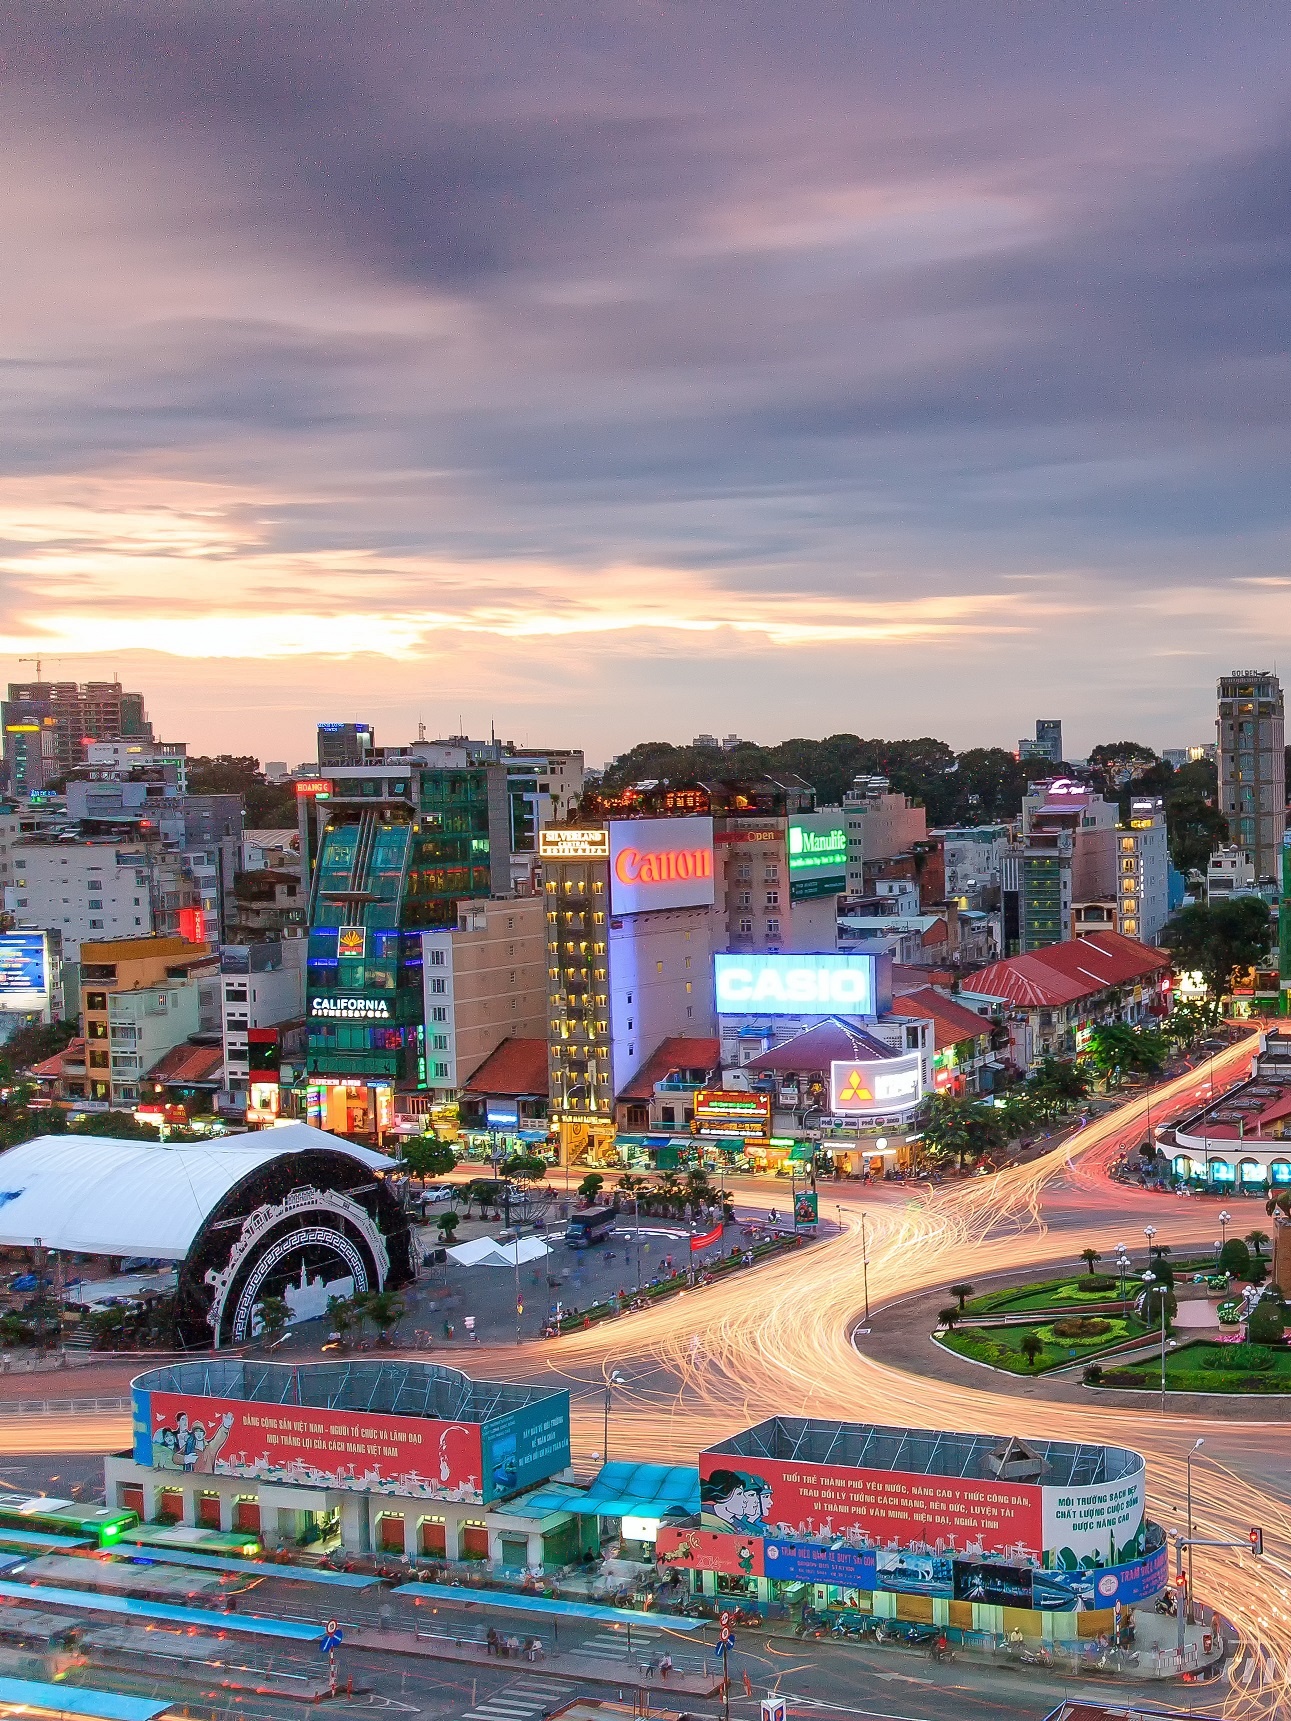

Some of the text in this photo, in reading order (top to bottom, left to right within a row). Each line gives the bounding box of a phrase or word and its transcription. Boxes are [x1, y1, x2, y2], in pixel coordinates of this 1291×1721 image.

[546, 832, 602, 841] SILVERLAND
[748, 832, 775, 842] Open
[802, 829, 847, 852] Manulife
[615, 847, 712, 885] Canon
[718, 968, 866, 1002] CASIO
[313, 998, 387, 1010] CALIFORNIA
[243, 1413, 260, 1427] ĐẢNG
[261, 1416, 278, 1430] CỘNG
[279, 1418, 292, 1431] SẢN
[293, 1421, 307, 1434] VIỆT
[309, 1423, 324, 1433] NAM
[330, 1424, 349, 1436] NGƯỜI
[351, 1424, 359, 1437] TỔ
[361, 1427, 378, 1439] CHỨC
[379, 1428, 388, 1440] VÀ
[390, 1430, 407, 1442] LÃNH
[408, 1434, 422, 1446] ĐẠO
[266, 1434, 398, 1457] MỌI THẮNG LỢI CỦA CÁCH MẠNG VIỆT NAM
[782, 1472, 800, 1483] TUỔI
[802, 1475, 817, 1484] TRẺ
[820, 1477, 845, 1488] THÀNH
[848, 1479, 863, 1489] PHỐ
[866, 1481, 883, 1491] YÊU
[885, 1483, 909, 1495] NƯỚC,
[912, 1486, 934, 1497] NÂNG
[936, 1489, 952, 1498] CAO
[955, 1490, 960, 1499] Ý
[964, 1491, 985, 1502] THỨC
[987, 1493, 1009, 1504] CÔNG
[1058, 1485, 1138, 1507] MÔI TRƯỜNG SẠCH ĐẸP
[799, 1488, 819, 1497] TRAU
[837, 1491, 846, 1500] LÝ
[849, 1492, 875, 1504] TƯỞNG
[878, 1494, 899, 1506] CÁCH
[901, 1499, 927, 1510] MẠNG,
[930, 1500, 946, 1511] RÈN
[970, 1506, 998, 1517] LUYỆN
[1001, 1507, 1014, 1518] TÀI
[1056, 1496, 1138, 1520] CHẤT LƯỢNG CUỘC SỐNG
[814, 1502, 999, 1529] VÌ THÀNH PHỐ VĂN MINH, HIỆN ĐẠI, NGHĨA TÌNH
[1073, 1512, 1130, 1532] ĐƯỢC NÂNG CAO
[829, 1552, 835, 1561] XE
